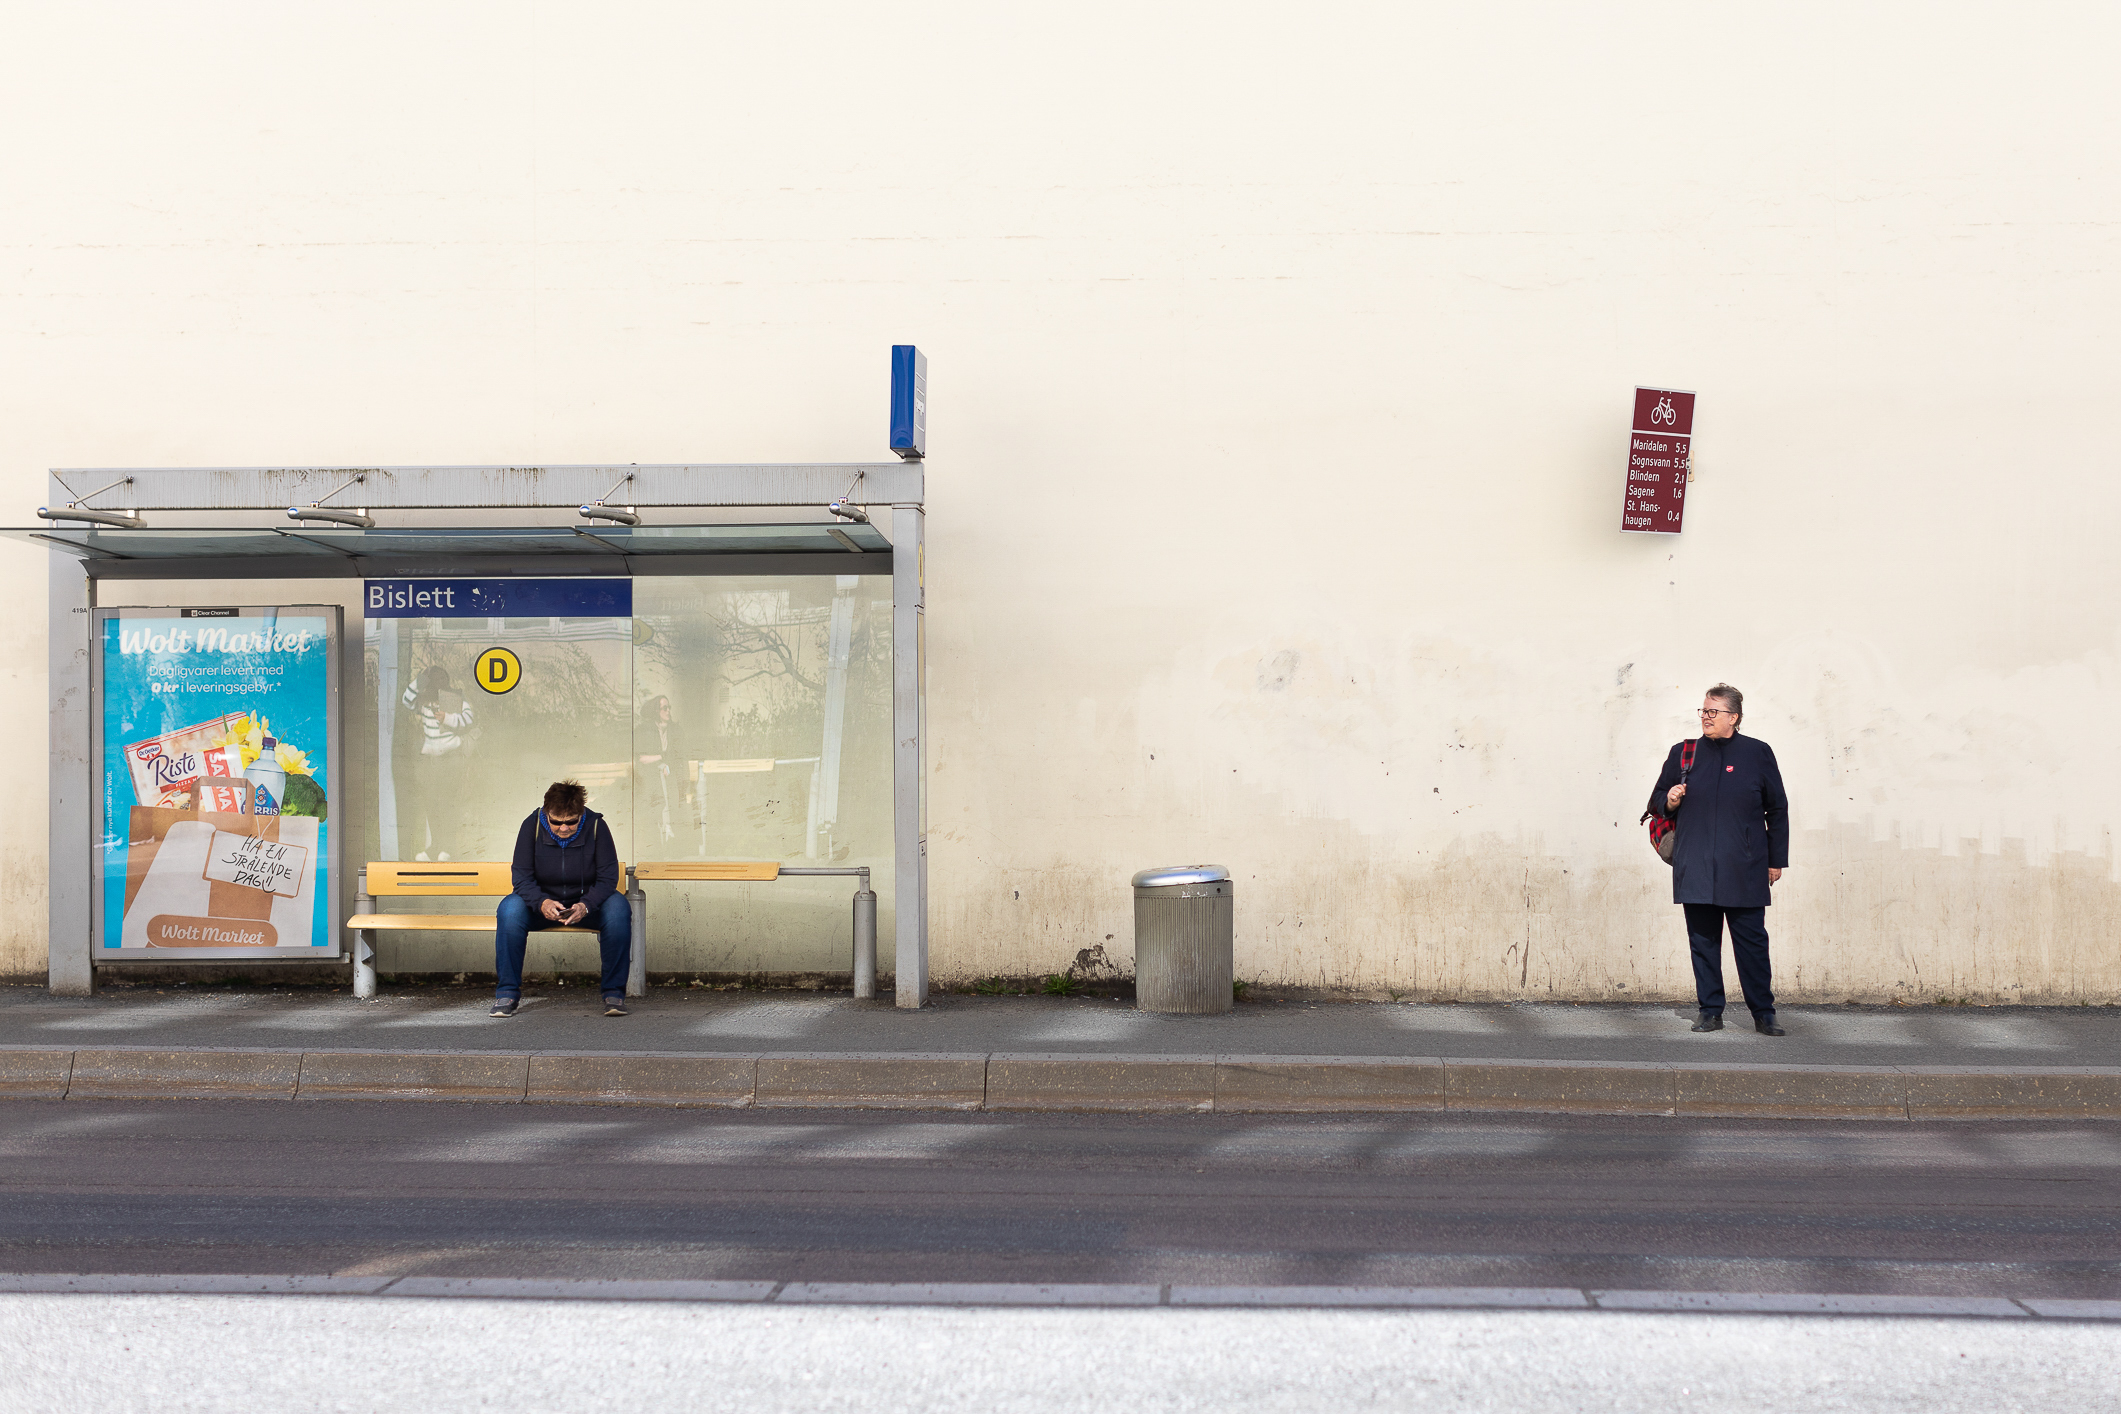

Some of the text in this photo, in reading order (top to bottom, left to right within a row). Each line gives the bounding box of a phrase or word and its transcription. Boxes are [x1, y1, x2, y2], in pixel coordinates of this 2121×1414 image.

[1632, 439, 1687, 454] Maridalen 5,5
[1631, 454, 1686, 469] Sognsvann 5,5
[1630, 469, 1685, 484] Blindern 2,1
[1628, 485, 1682, 499] Sagene 1,6
[1627, 500, 1661, 512] St. Hans-
[1625, 514, 1652, 527] haugen
[1667, 510, 1680, 522] 0,4
[369, 584, 455, 609] Bislett
[119, 627, 312, 655] Wolt Market
[149, 665, 284, 679] Dagligvarer levert med
[488, 657, 508, 684] D
[151, 682, 162, 693] 0
[163, 681, 180, 693] kr
[175, 779, 191, 787] PIZZA
[209, 752, 232, 811] SAMA
[241, 834, 288, 861] HA EN
[221, 852, 293, 880] STRÅLENDE
[232, 870, 262, 887] DAG
[161, 924, 265, 945] Wolt Market
